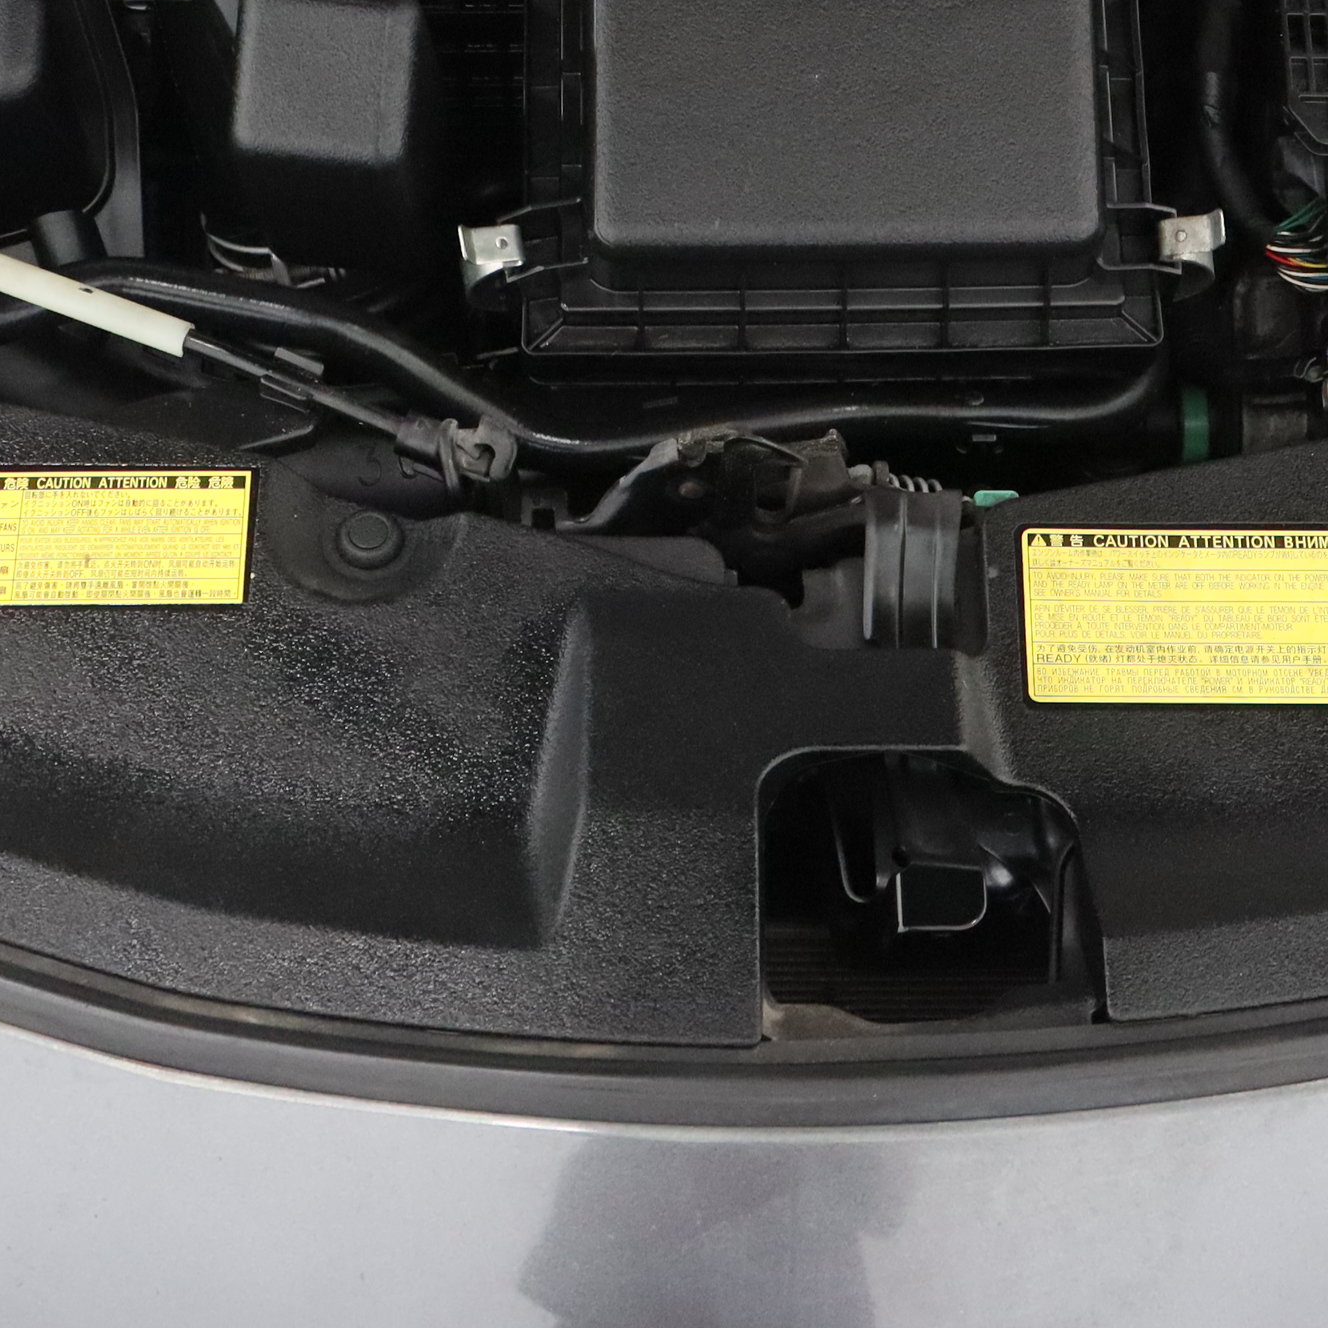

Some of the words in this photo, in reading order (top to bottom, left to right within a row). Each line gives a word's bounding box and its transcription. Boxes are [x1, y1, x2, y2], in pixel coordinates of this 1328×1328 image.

[36, 477, 90, 489] CAUTION
[98, 477, 167, 489] ATTENTION
[0, 523, 17, 531] FANS
[1049, 534, 1083, 546] 警告
[1093, 535, 1168, 546] CAUTION
[1178, 535, 1275, 547] ATTENTION
[1036, 654, 1081, 662] READY
